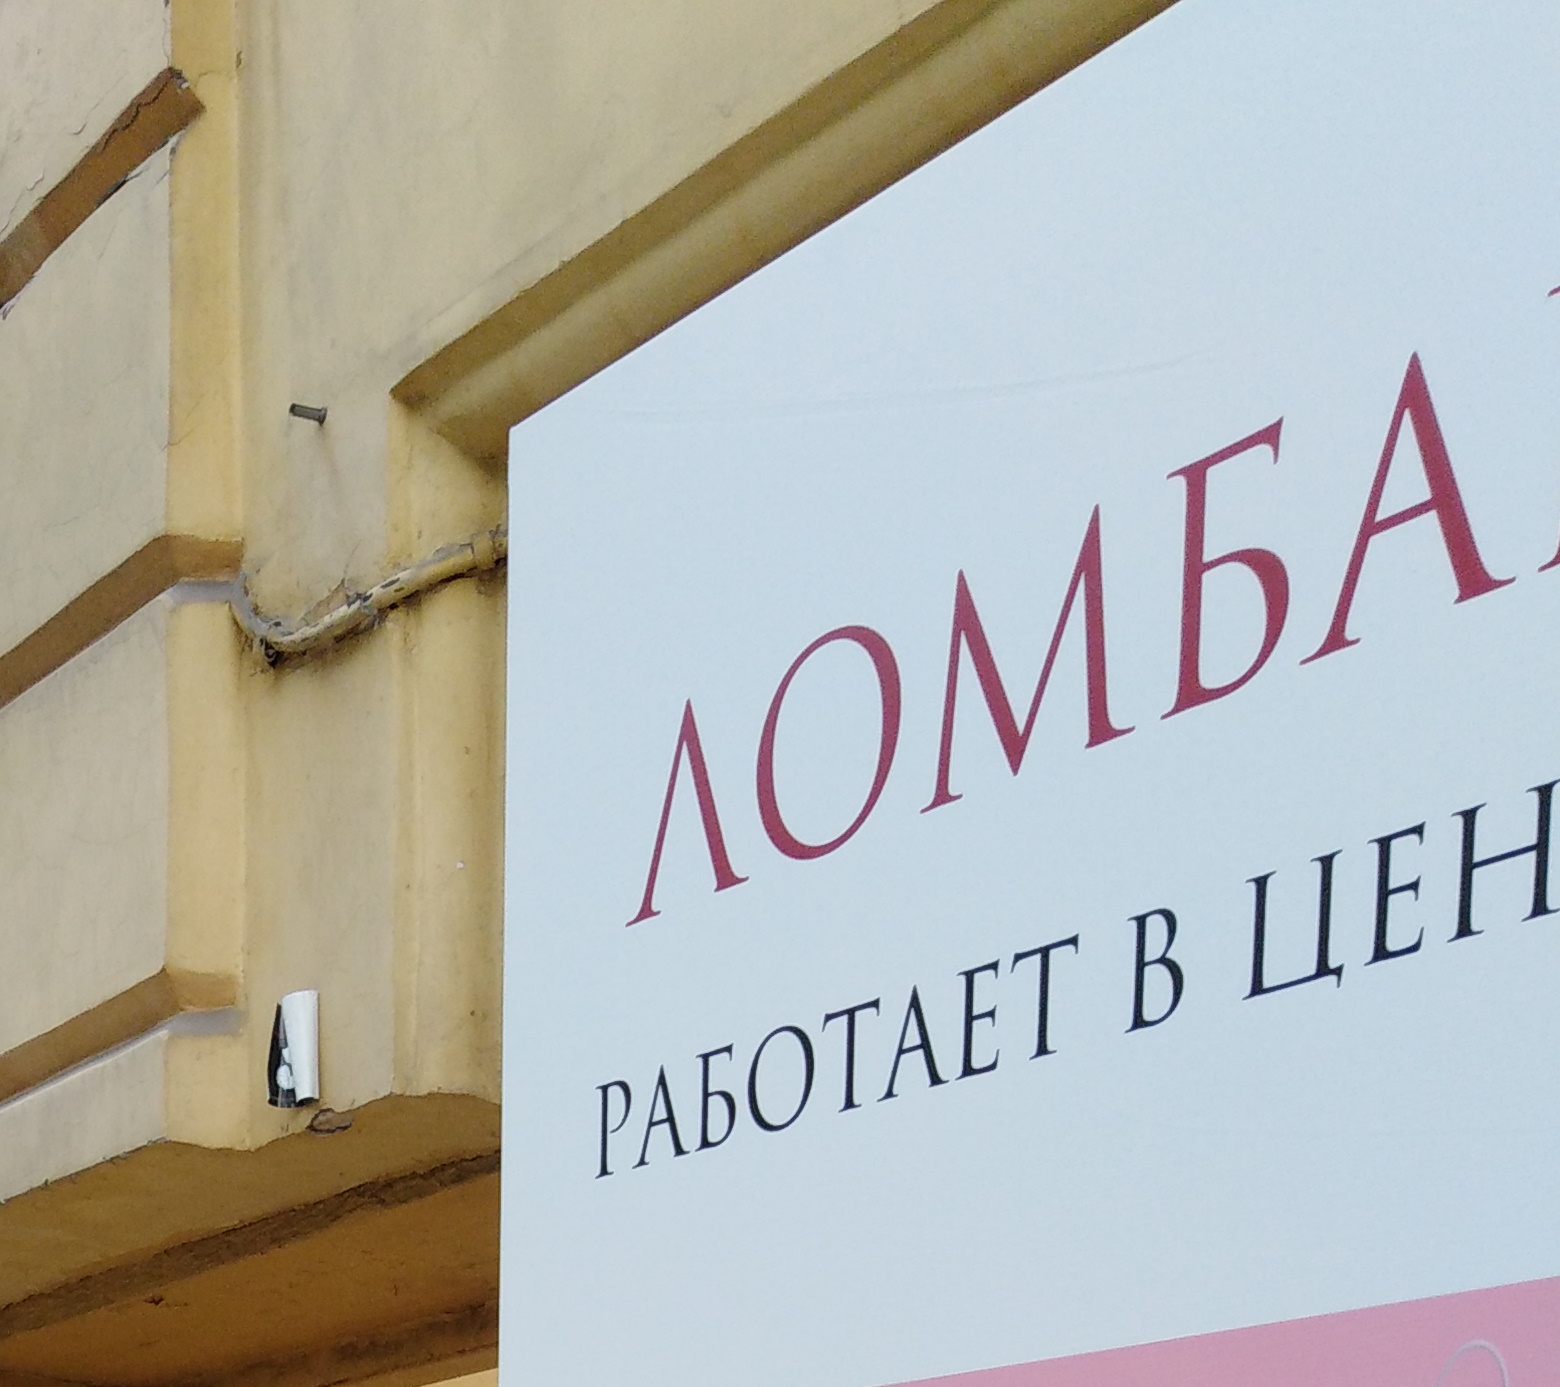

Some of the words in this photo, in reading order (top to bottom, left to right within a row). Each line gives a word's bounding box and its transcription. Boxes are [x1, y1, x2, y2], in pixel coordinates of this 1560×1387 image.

[627, 283, 1560, 927] ЛОМБА
[595, 934, 1079, 1179] РАБОТАЕТ
[1125, 907, 1184, 1034] В
[1242, 778, 1560, 1001] ЦЕН
